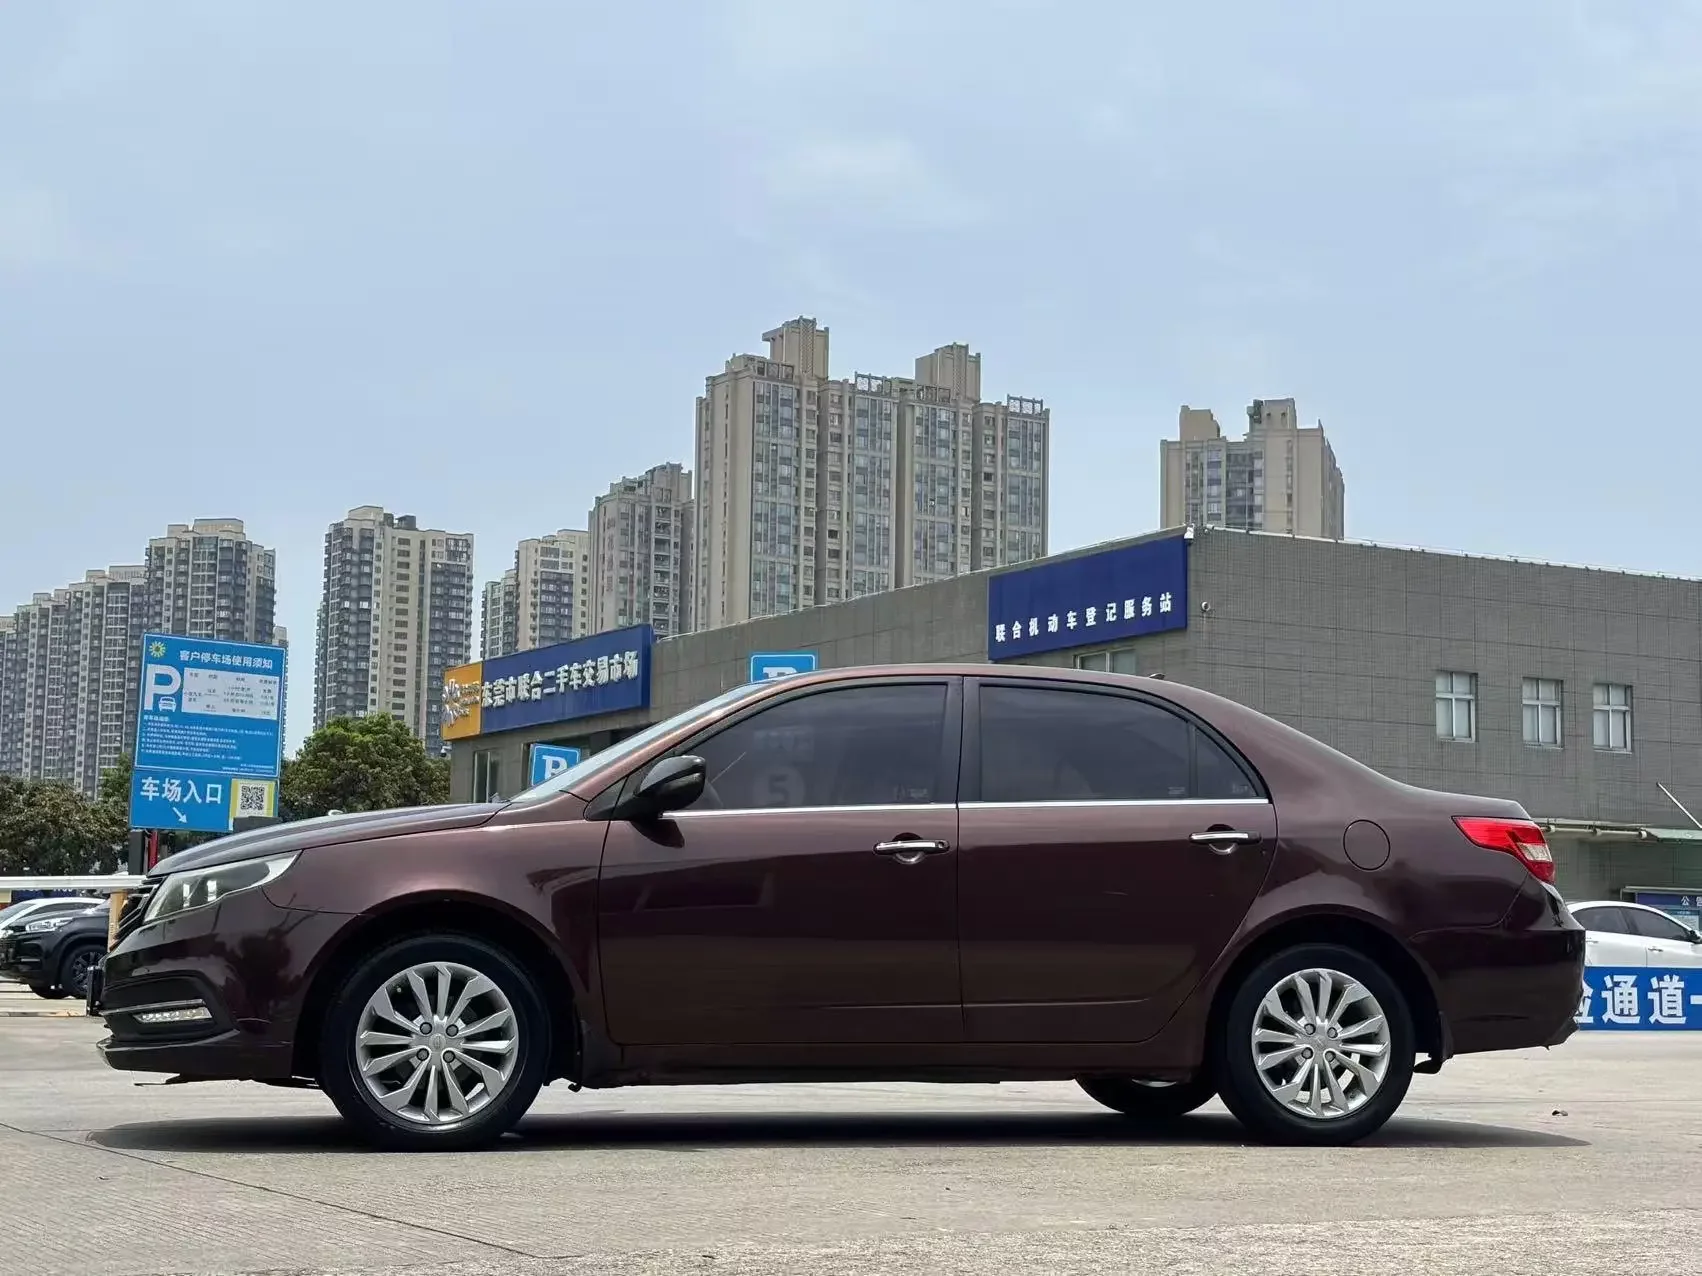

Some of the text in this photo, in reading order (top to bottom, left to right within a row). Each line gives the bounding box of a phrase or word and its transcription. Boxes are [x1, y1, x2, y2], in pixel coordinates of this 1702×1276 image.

[995, 592, 1172, 642] 联合机动车登记服务站
[179, 650, 273, 670] 客户停车场使用须知
[481, 651, 638, 708] 东莞市联合二手车交易市场
[144, 664, 181, 710] P
[140, 776, 222, 804] 车场入口
